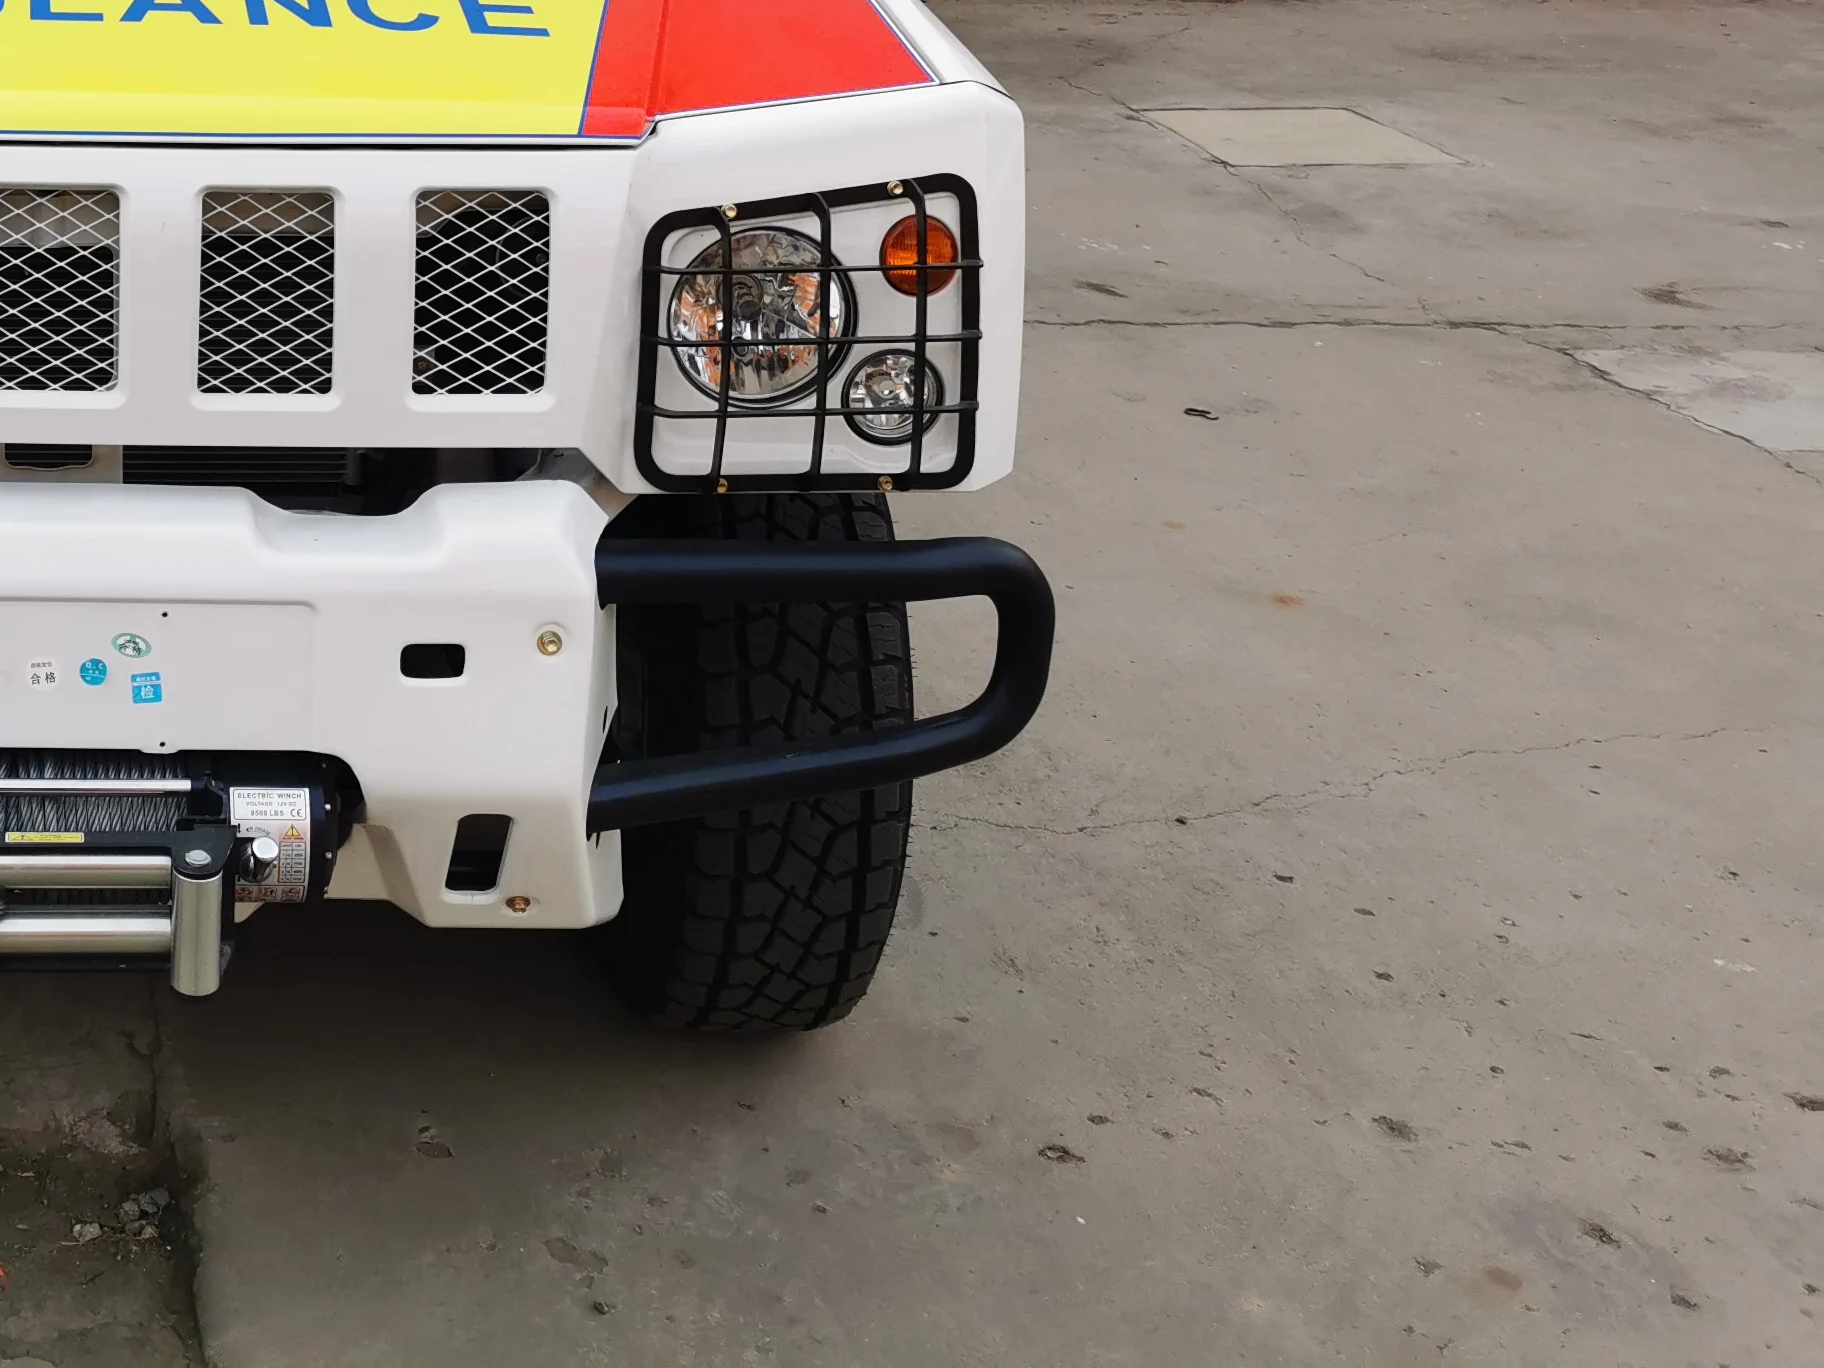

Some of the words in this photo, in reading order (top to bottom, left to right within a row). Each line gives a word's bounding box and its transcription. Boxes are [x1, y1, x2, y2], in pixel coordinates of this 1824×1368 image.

[29, 671, 56, 686] 合格
[140, 685, 155, 699] 检
[237, 792, 274, 800] ELECTRIC
[277, 792, 302, 800] WINCH
[269, 809, 285, 817] LBS
